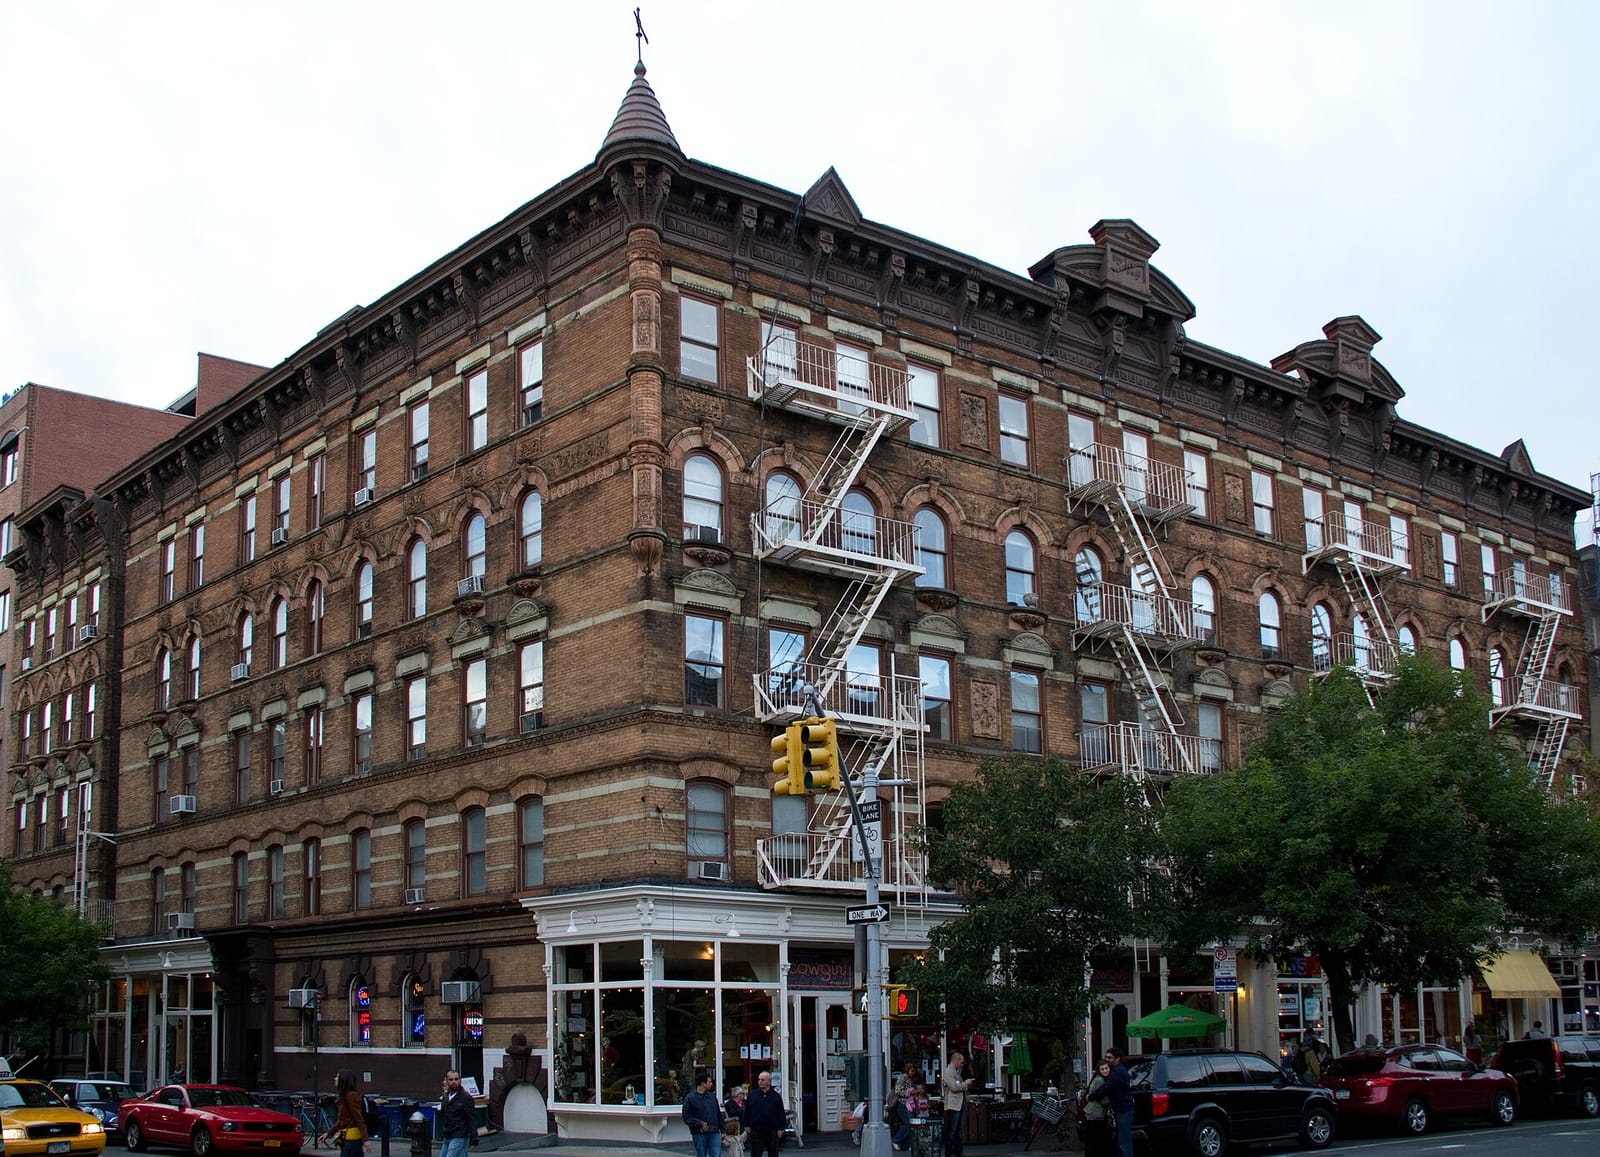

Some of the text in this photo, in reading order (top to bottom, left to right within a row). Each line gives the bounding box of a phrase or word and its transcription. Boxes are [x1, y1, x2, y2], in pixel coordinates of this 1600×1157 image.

[862, 804, 878, 812] BIKE
[861, 812, 879, 820] LANE
[859, 847, 875, 856] OLY
[852, 909, 883, 919] ONE WAY
